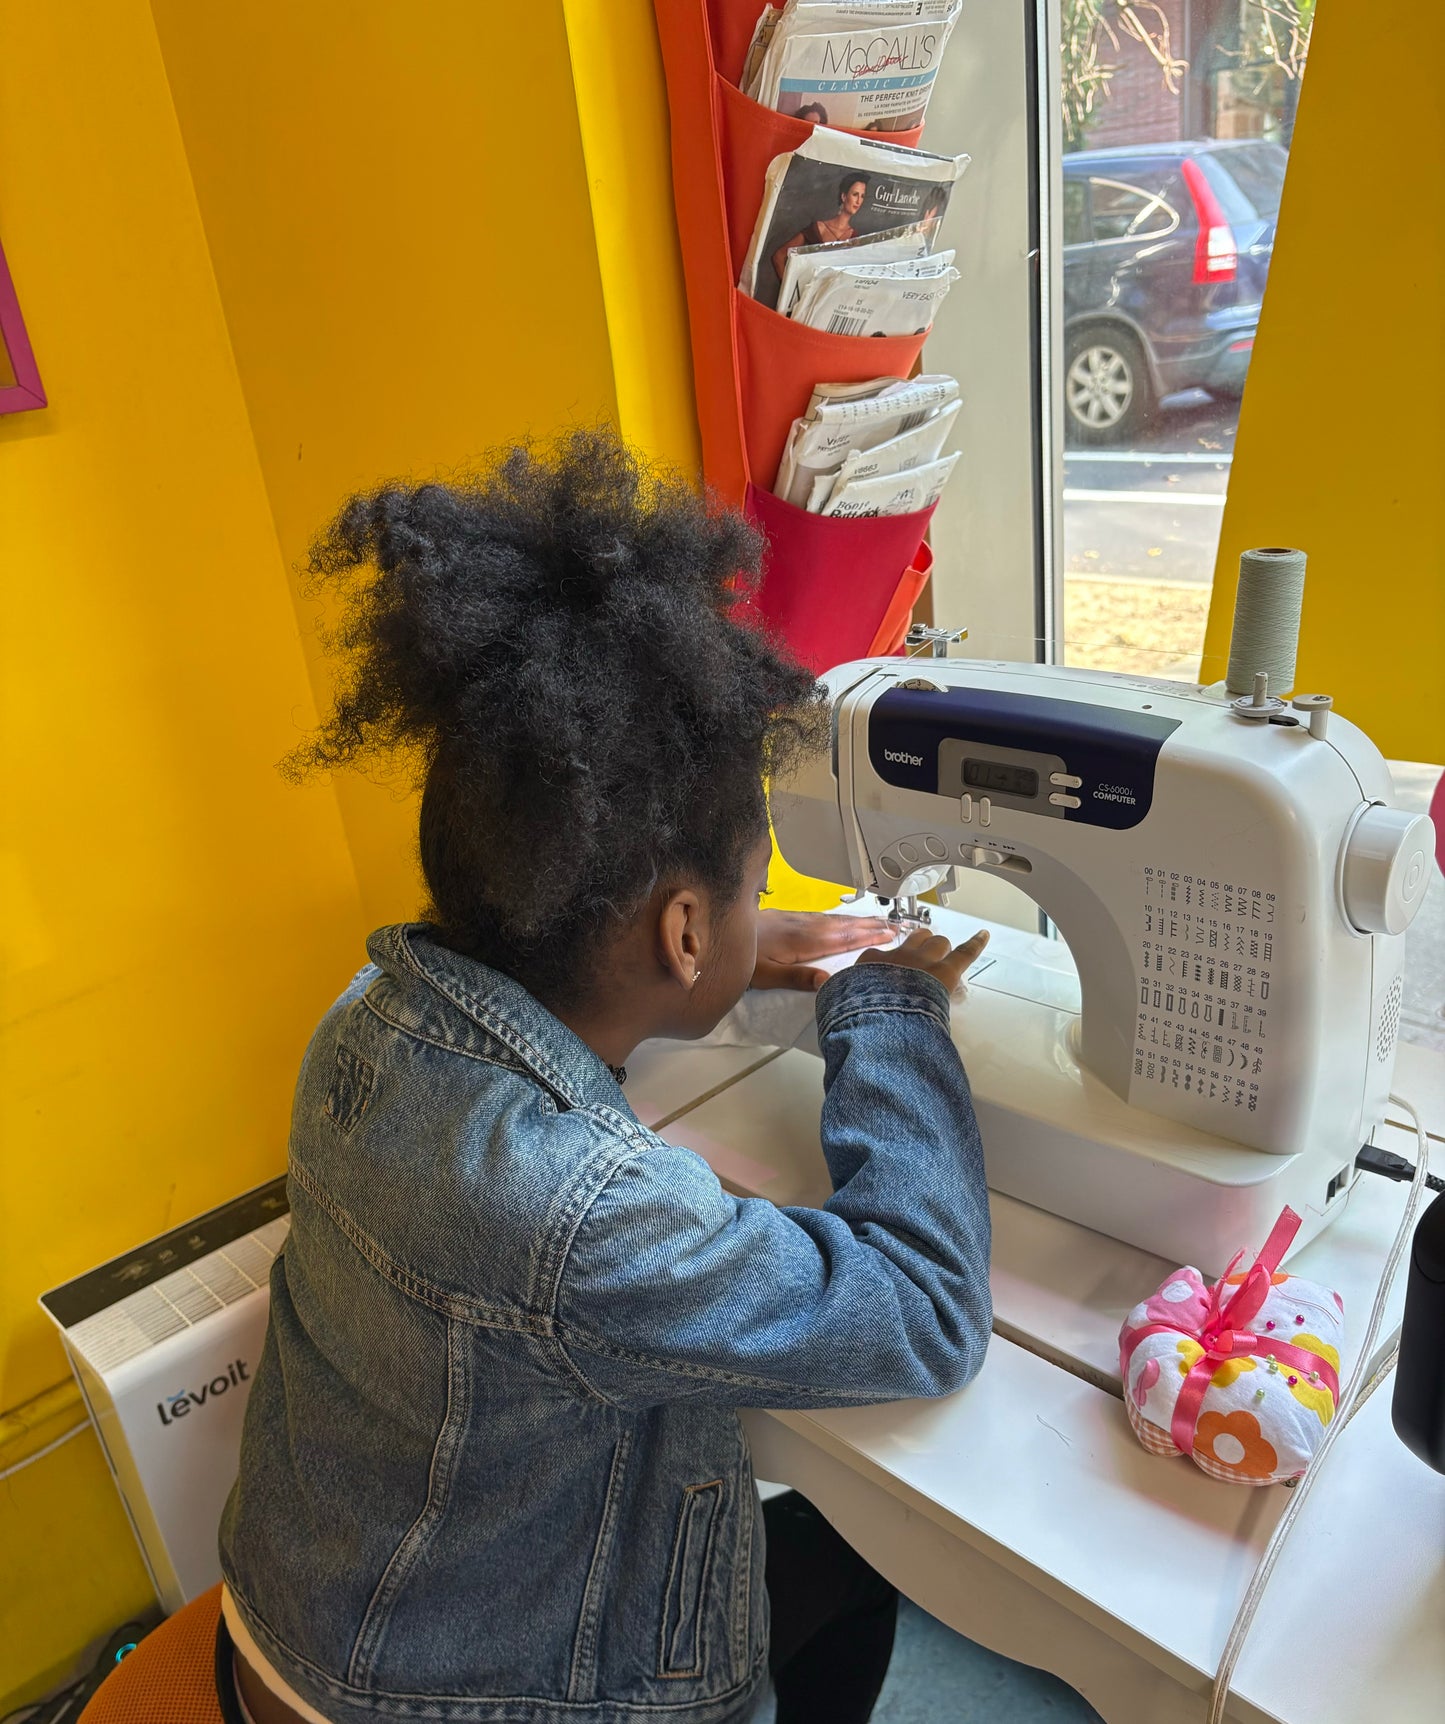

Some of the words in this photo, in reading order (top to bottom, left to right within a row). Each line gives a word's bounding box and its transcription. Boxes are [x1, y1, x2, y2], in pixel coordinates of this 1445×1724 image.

[818, 79, 890, 91] CLASSIC
[901, 76, 925, 87] FIT
[860, 94, 874, 103] THE
[875, 92, 905, 102] PERFECT
[905, 89, 919, 99] KNIT
[875, 185, 895, 206] Guy
[902, 291, 919, 300] VERY
[884, 749, 923, 766] brother
[1099, 783, 1133, 796] CS-6000i
[1092, 791, 1136, 806] COMPUTER
[1144, 867, 1153, 875] 00
[1238, 887, 1247, 895] 07
[1168, 947, 1176, 955] 22
[1206, 957, 1215, 965] 25
[1141, 977, 1149, 985] 30
[1178, 987, 1187, 995] 33
[1230, 1001, 1239, 1009] 37
[1244, 1005, 1253, 1013] 38
[1201, 1031, 1210, 1039] 45
[1254, 1046, 1263, 1054] 49
[1136, 1048, 1143, 1056] 50
[1186, 1063, 1194, 1071] 54
[1198, 1067, 1206, 1075] 55
[1210, 1071, 1219, 1079] 56
[1237, 1079, 1245, 1087] 58
[1250, 1083, 1258, 1091] 59
